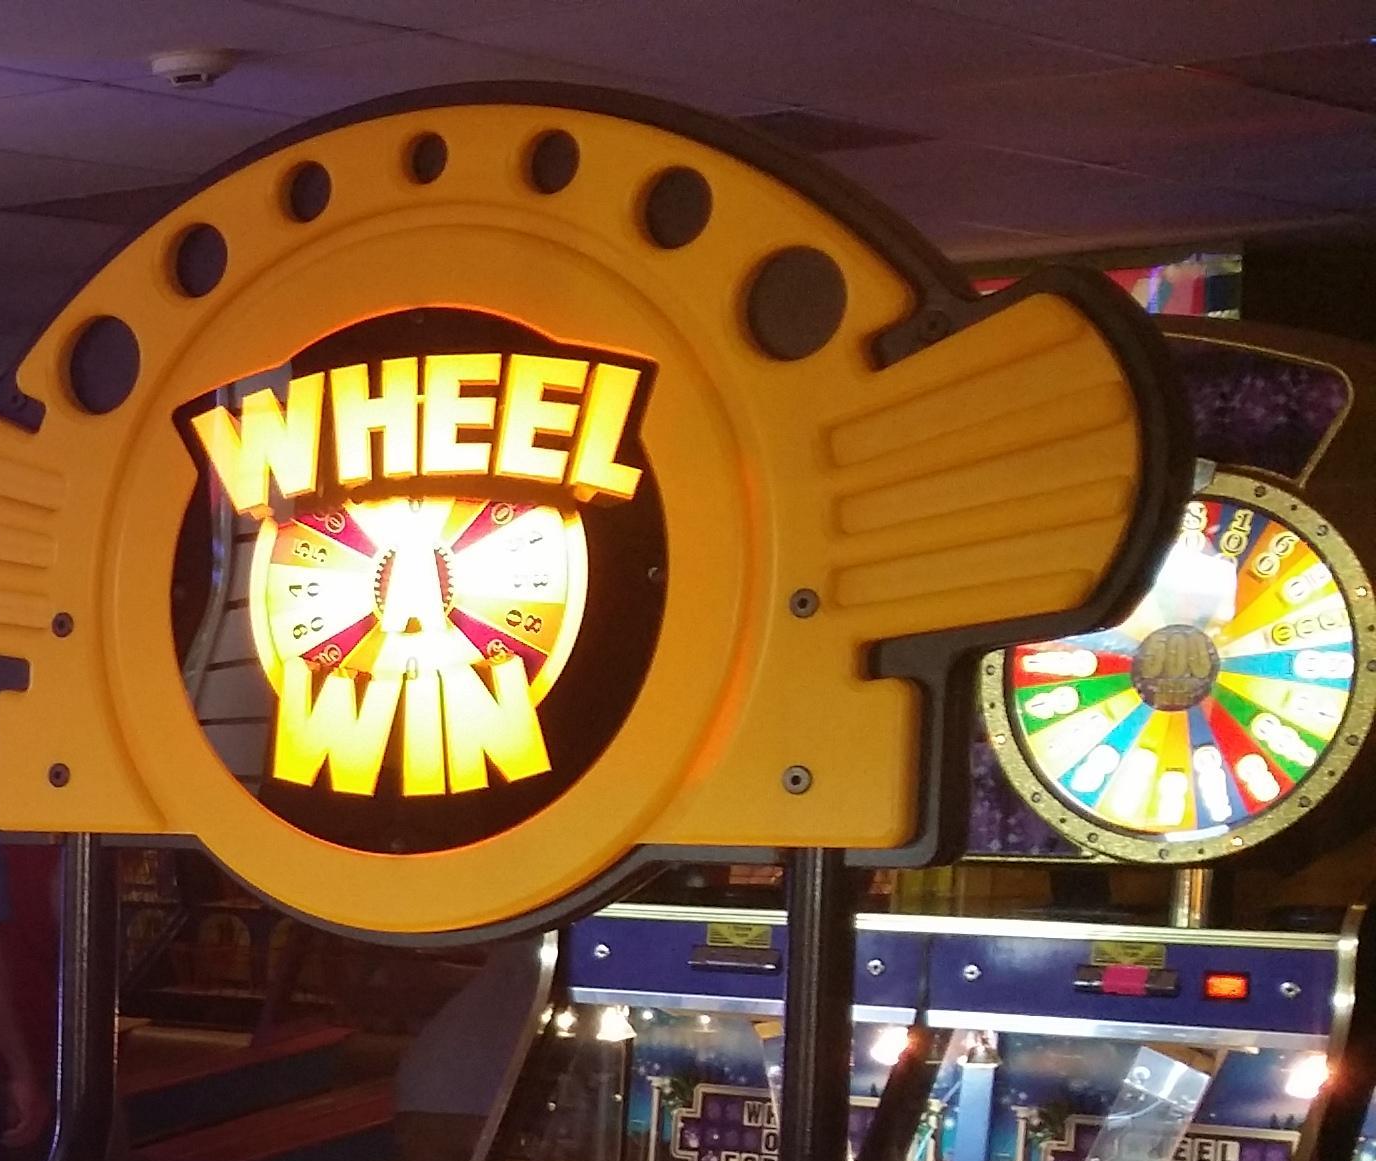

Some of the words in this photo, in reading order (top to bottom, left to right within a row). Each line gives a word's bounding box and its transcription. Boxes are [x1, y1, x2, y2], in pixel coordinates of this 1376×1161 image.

[191, 353, 643, 516] WHEEL
[380, 535, 448, 633] A
[273, 655, 552, 798] WIN
